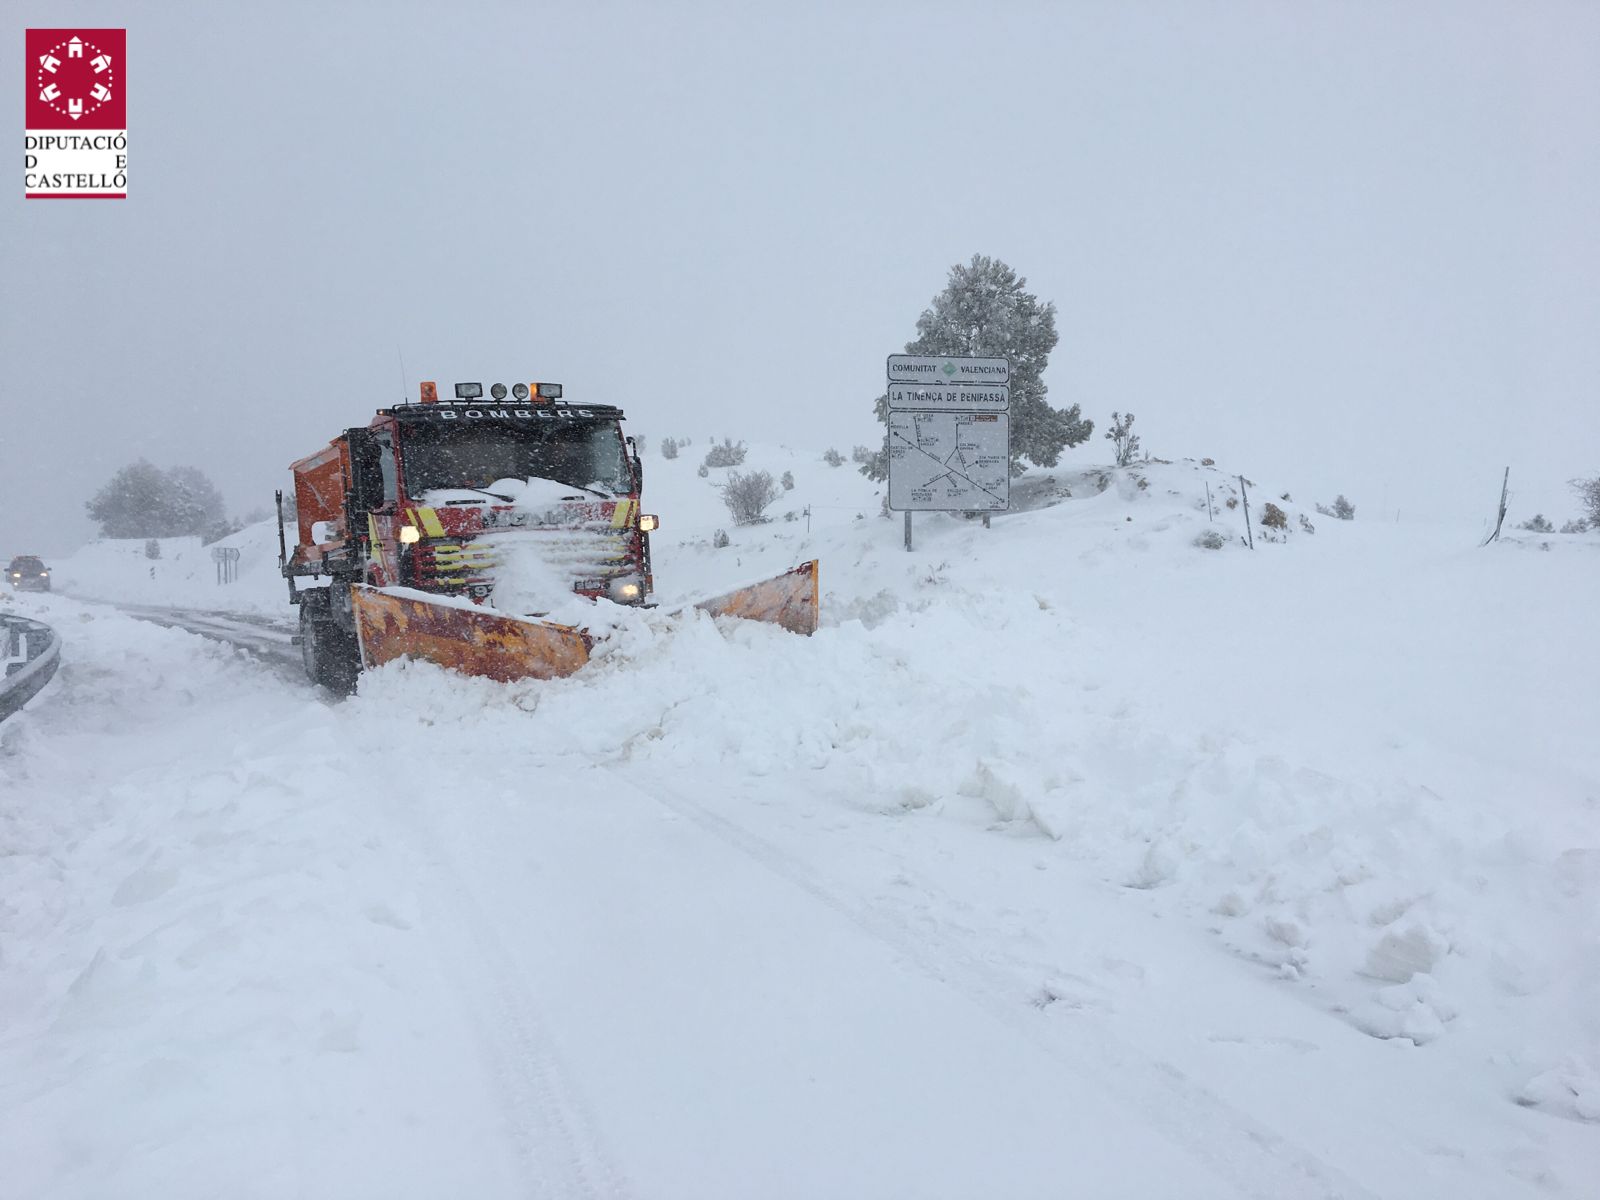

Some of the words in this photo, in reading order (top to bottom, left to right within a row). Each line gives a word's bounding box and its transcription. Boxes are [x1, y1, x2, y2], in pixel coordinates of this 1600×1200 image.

[892, 364, 937, 372] COMUNITAT
[960, 365, 1007, 374] VALENCIANA
[892, 391, 903, 401] LA
[907, 391, 943, 403] TINENÇA
[946, 392, 957, 402] DE
[960, 390, 1006, 403] BENIFASSÀ
[440, 409, 595, 420] BOMBERS
